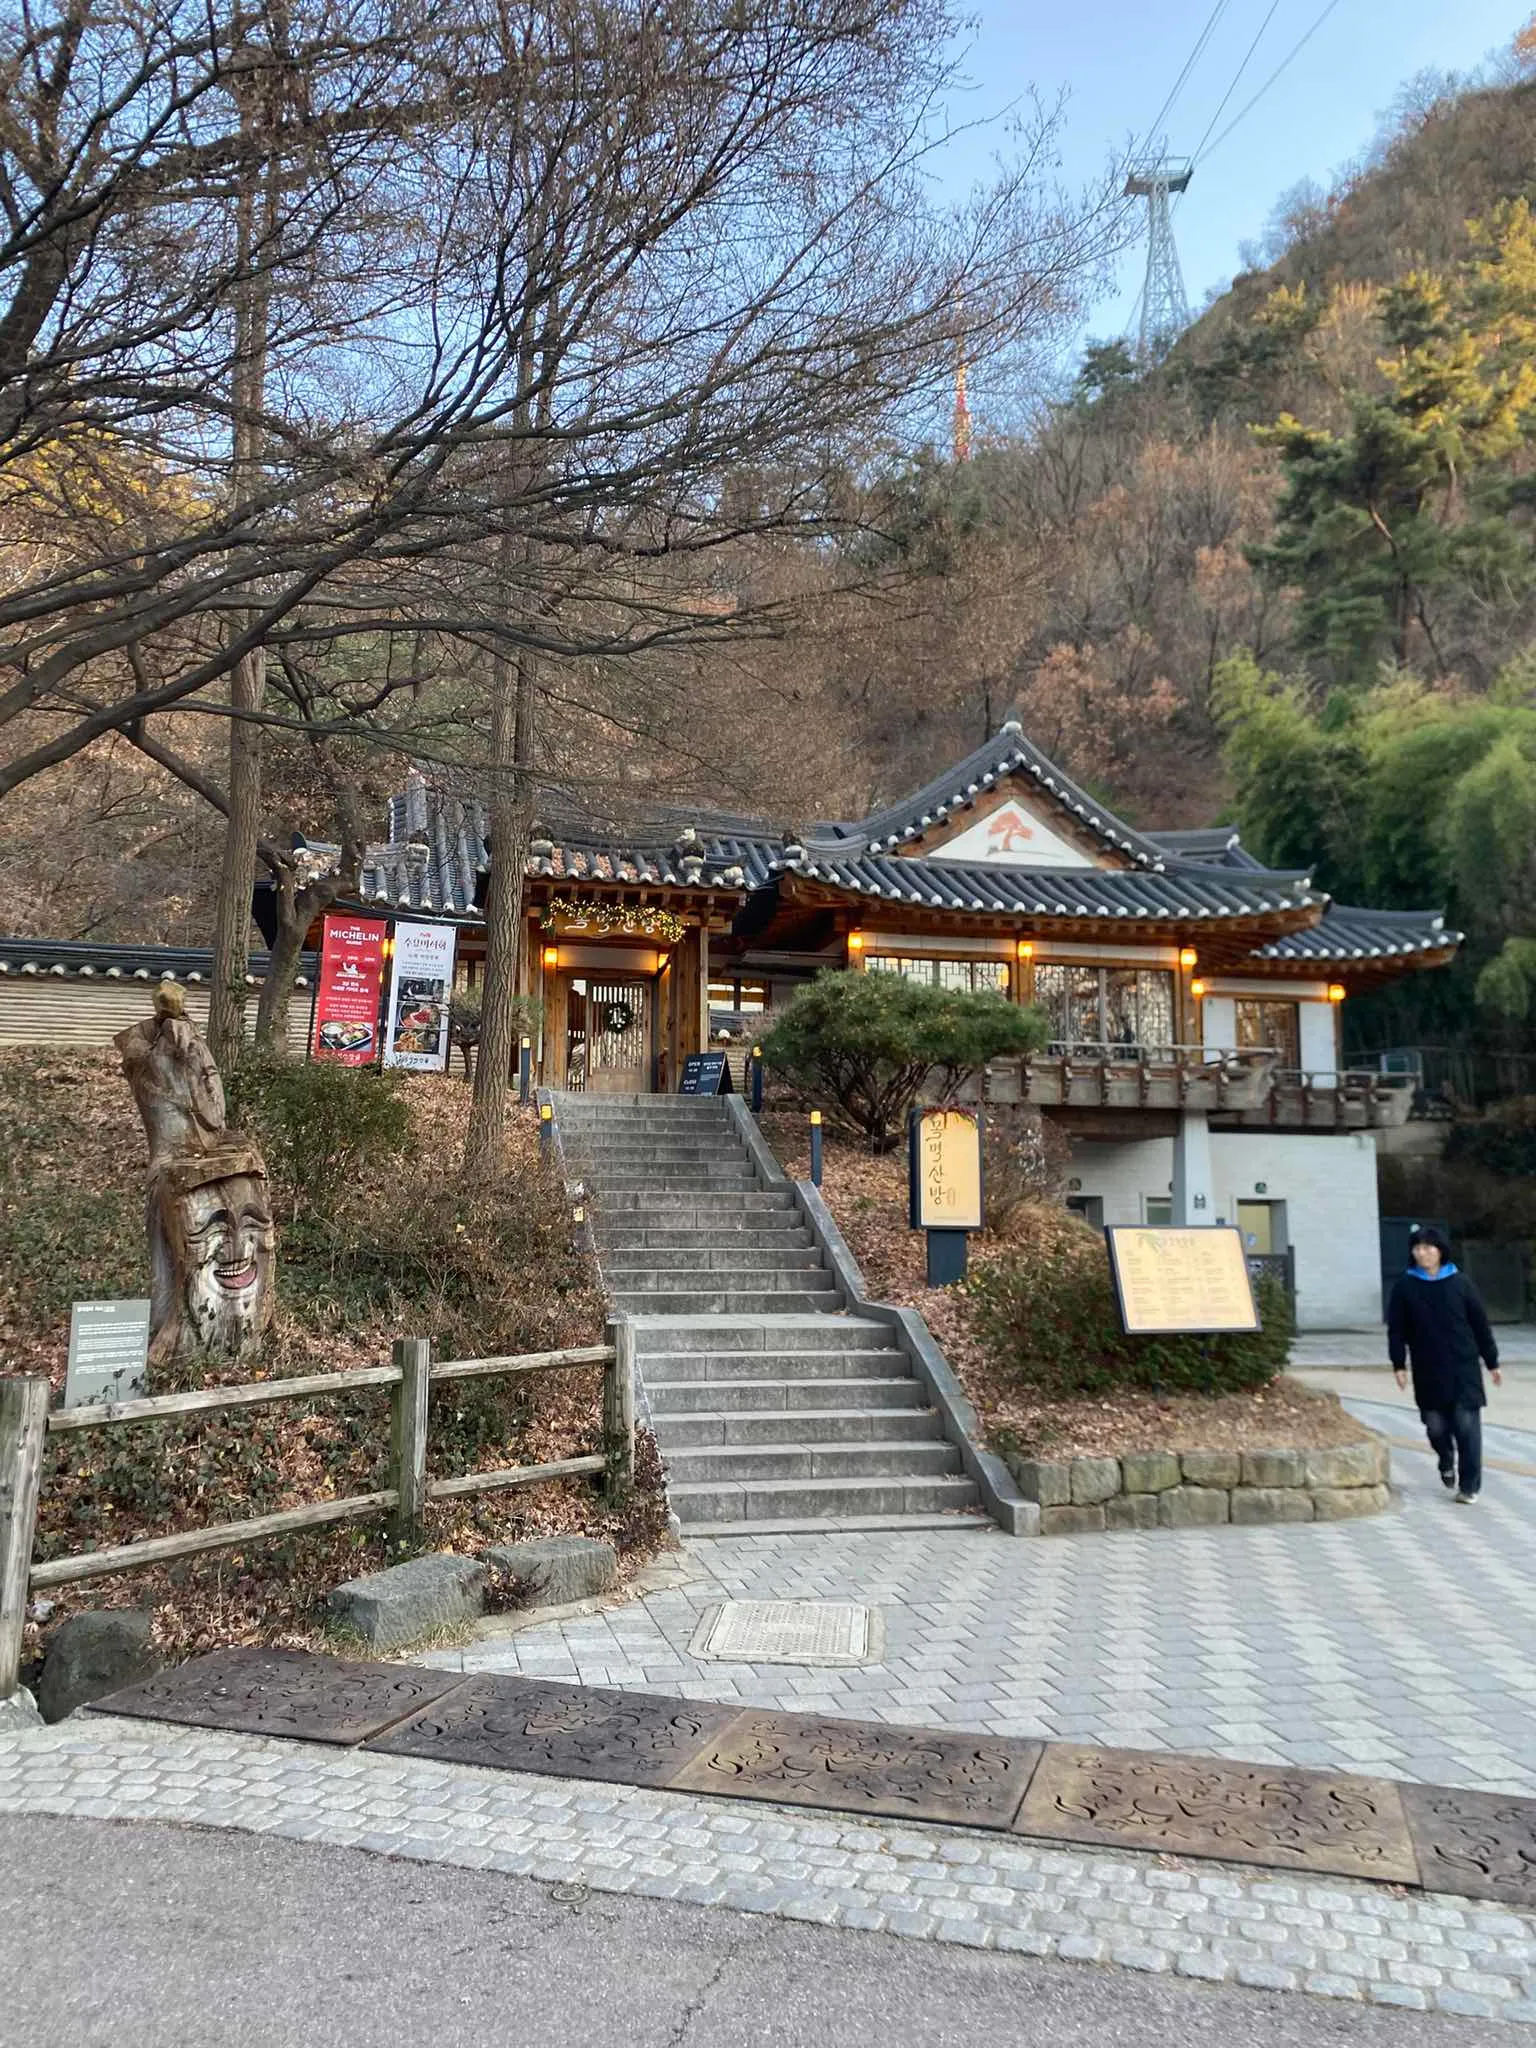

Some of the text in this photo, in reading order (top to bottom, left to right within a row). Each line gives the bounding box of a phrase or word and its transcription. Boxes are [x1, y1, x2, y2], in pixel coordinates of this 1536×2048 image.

[329, 929, 379, 942] MICHELIN
[404, 937, 447, 950] 수요미식회
[925, 1119, 946, 1205] 목멱산방
